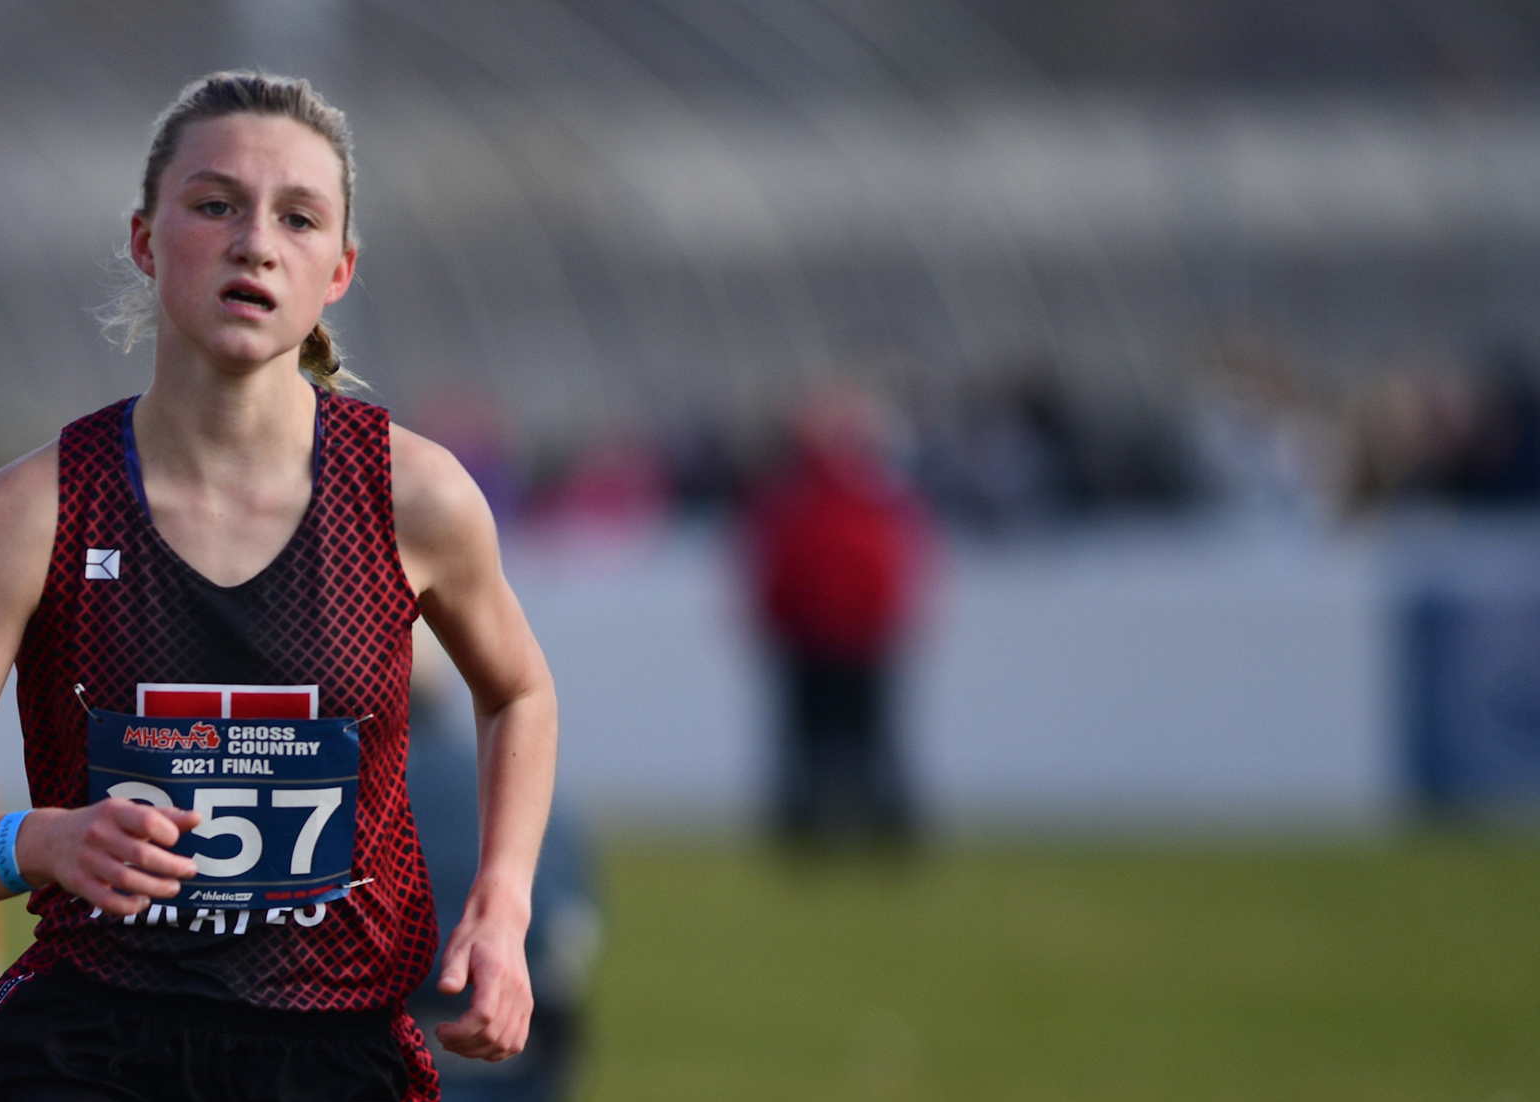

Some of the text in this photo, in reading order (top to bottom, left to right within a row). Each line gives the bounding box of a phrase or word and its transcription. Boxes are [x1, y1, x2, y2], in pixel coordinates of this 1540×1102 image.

[123, 725, 208, 749] MHSAA
[228, 726, 295, 741] CROSS
[228, 741, 320, 755] COUNTRY
[171, 758, 274, 774] 2021 FINAL
